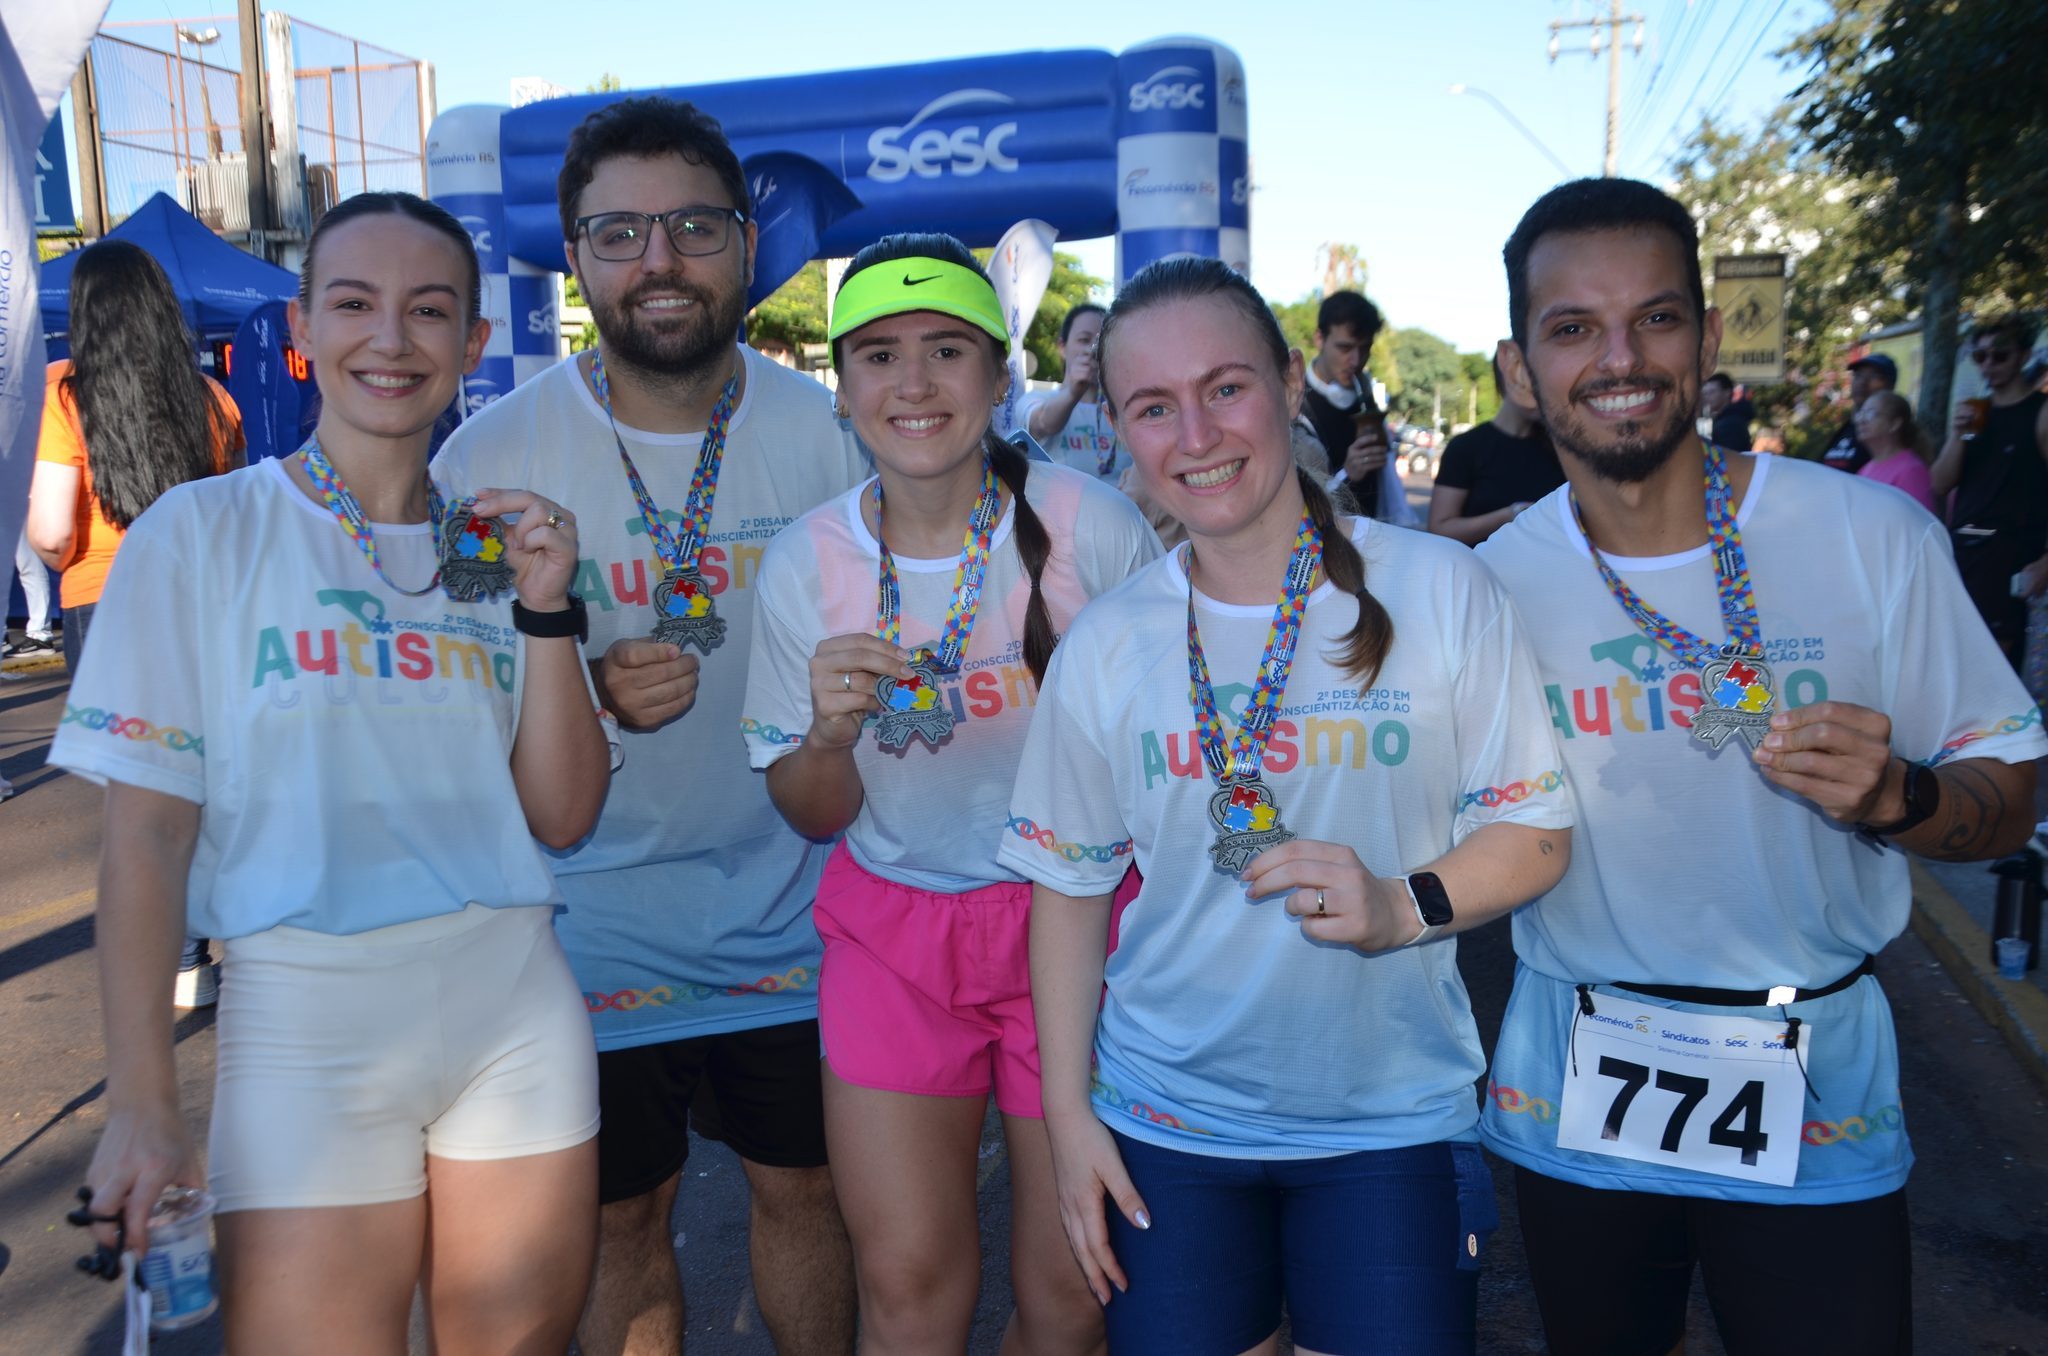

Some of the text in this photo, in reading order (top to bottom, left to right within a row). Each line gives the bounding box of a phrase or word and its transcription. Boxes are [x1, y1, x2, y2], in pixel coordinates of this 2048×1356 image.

[1129, 83, 1204, 113] Sesc
[867, 121, 1019, 184] Sesc
[1804, 637, 1824, 648] EM
[1804, 650, 1825, 661] AO
[1393, 690, 1410, 701] EM
[1277, 699, 1410, 717] ONSCIENTIZAÇÃO AO
[1240, 834, 1276, 844] AUTISMO
[1636, 1023, 1649, 1034] RS
[1661, 1029, 1711, 1046] Sindicatos
[1725, 1038, 1749, 1049] Sesc
[1598, 1055, 1769, 1167] 774
